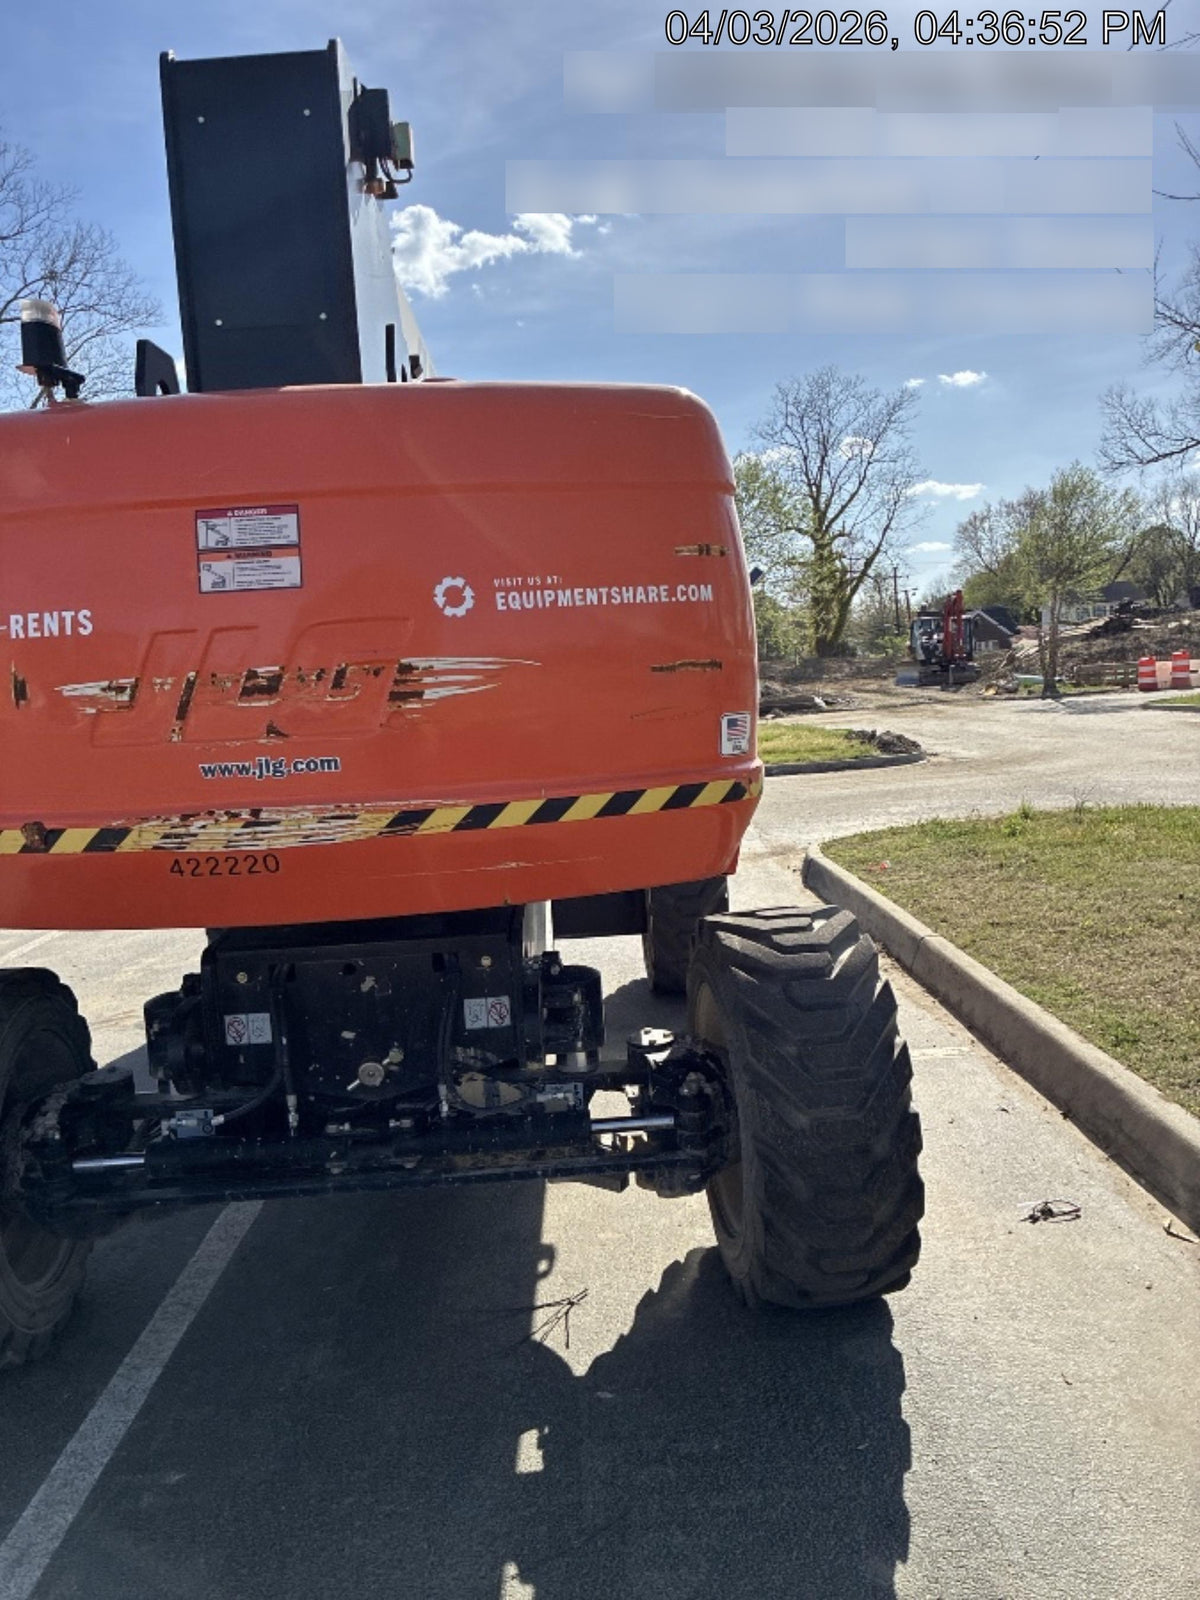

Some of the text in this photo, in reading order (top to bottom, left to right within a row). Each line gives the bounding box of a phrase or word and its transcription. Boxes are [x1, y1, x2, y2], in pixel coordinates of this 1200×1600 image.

[493, 577, 523, 587] VISIT
[527, 576, 542, 586] US
[495, 584, 713, 611] EQUIPMENTSHARE.COM
[199, 756, 341, 780] www.jlg.com
[169, 853, 280, 877] 422220
